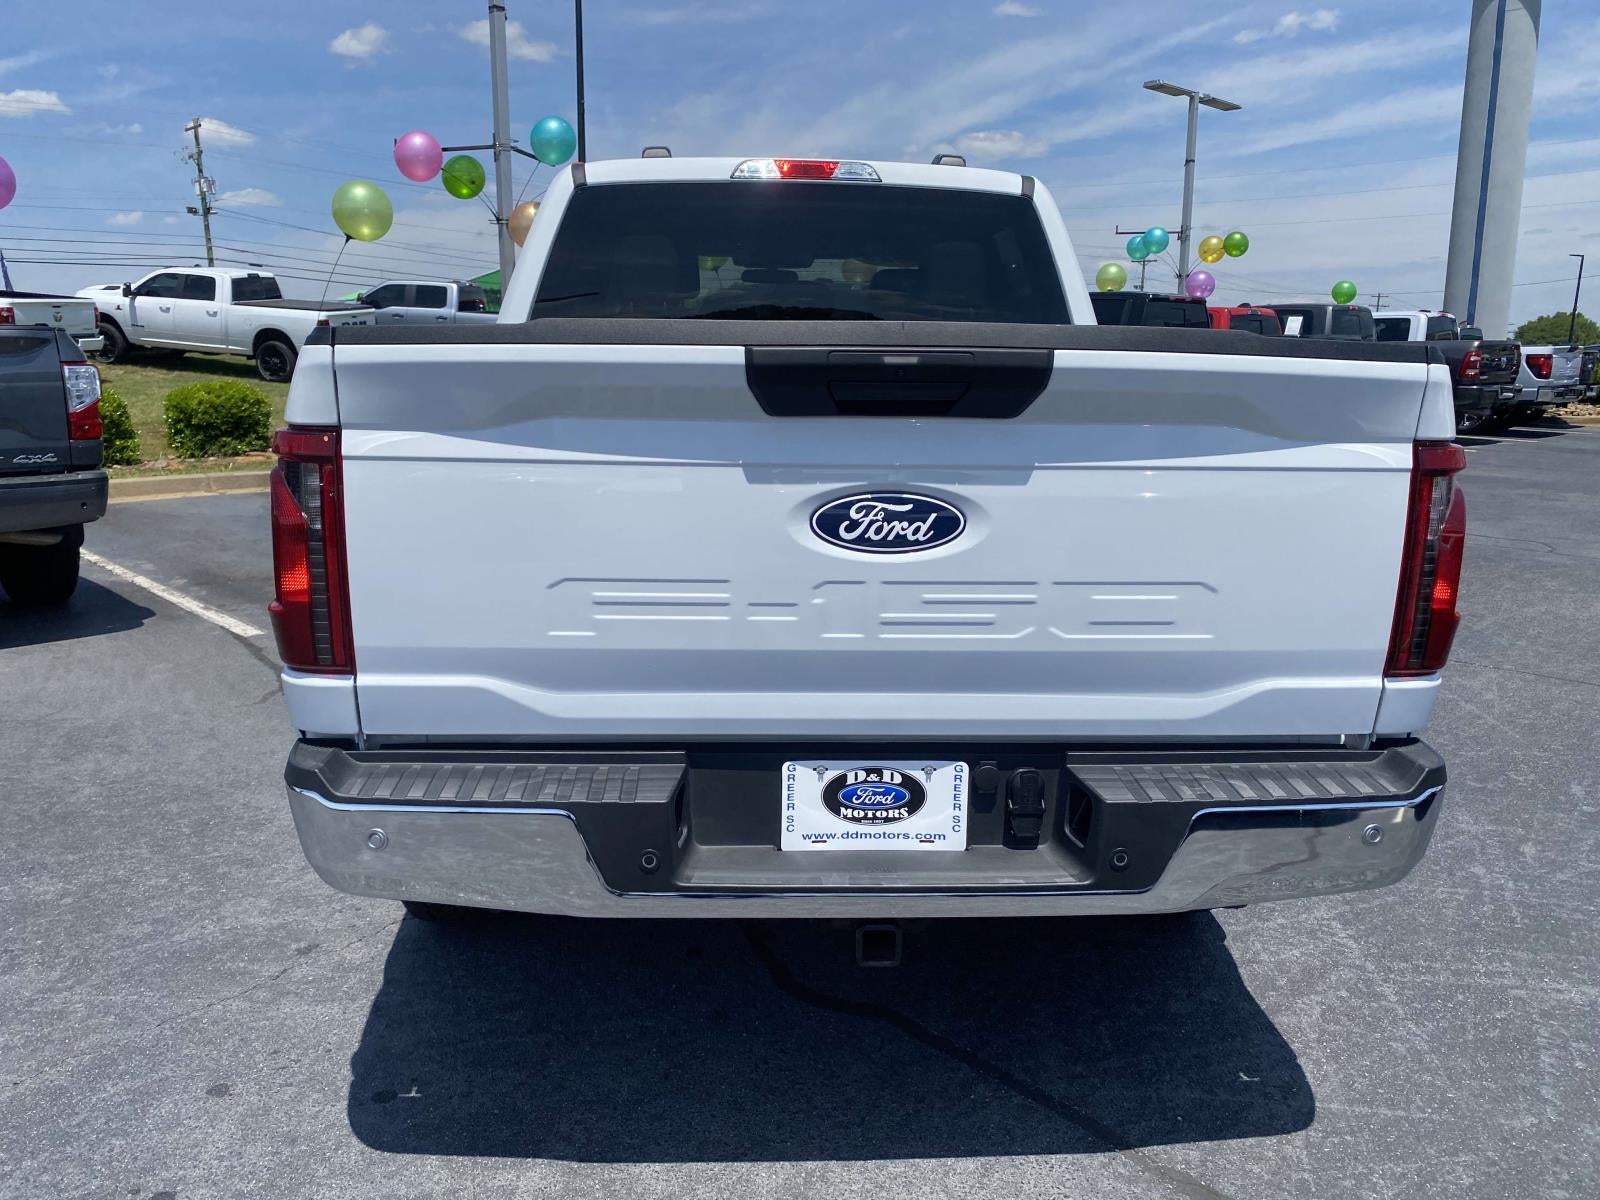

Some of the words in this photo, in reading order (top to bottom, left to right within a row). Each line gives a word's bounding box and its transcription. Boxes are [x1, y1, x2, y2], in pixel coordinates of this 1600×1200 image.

[838, 501, 938, 541] Ford
[846, 769, 903, 786] D&D
[787, 764, 796, 811] GREER
[852, 787, 895, 805] Ford
[953, 764, 963, 811] GREER
[839, 806, 909, 818] MOTORS
[786, 815, 795, 833] SC
[952, 815, 961, 833] SC
[802, 831, 946, 841] www.ddmotors.com
